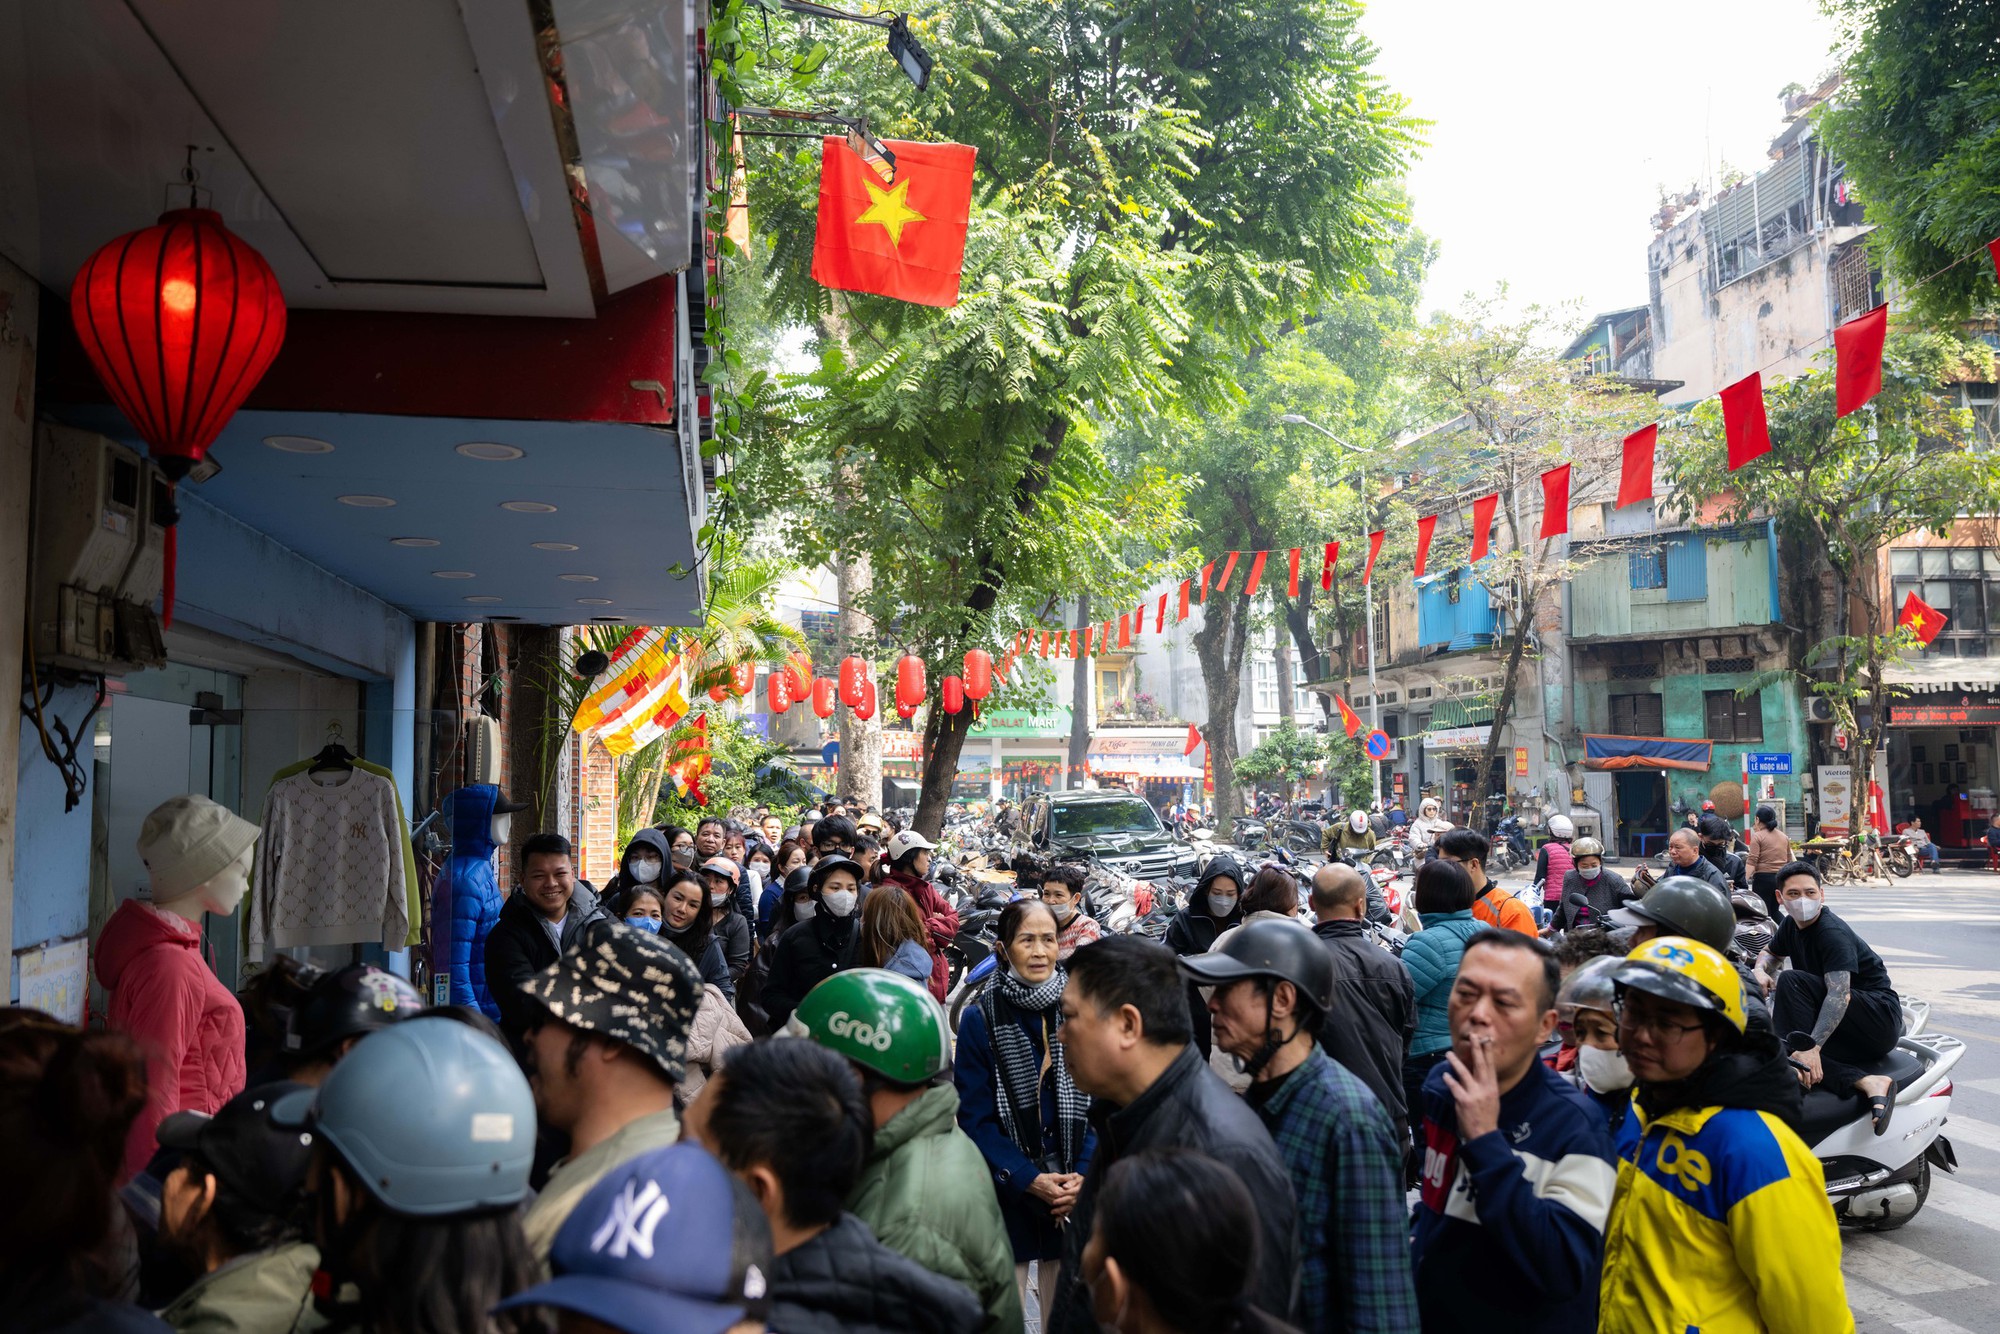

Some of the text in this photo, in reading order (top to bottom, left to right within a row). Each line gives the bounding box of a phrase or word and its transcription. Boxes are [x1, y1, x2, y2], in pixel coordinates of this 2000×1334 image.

[991, 715, 1058, 729] DALAT MART
[1759, 763, 1775, 772] NGỌC
[828, 1011, 892, 1051] Grab
[590, 1177, 670, 1260] NY
